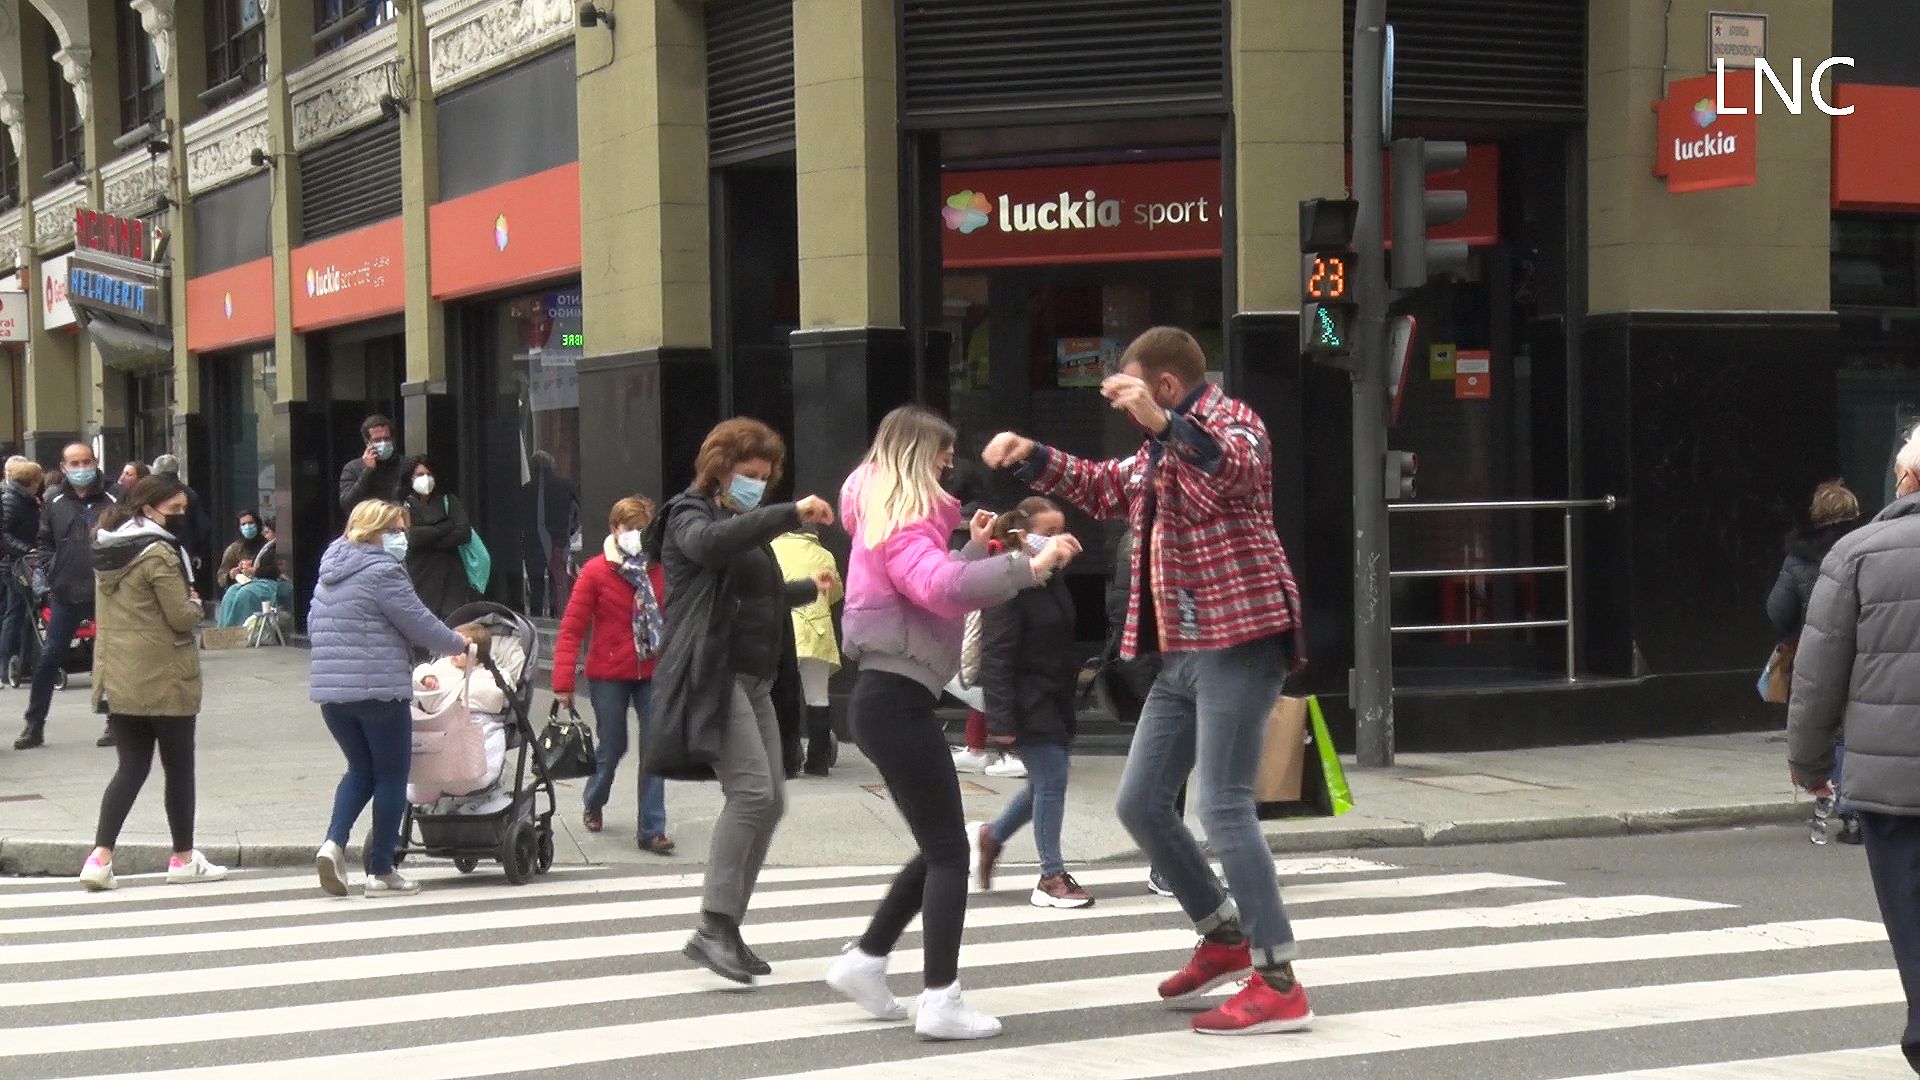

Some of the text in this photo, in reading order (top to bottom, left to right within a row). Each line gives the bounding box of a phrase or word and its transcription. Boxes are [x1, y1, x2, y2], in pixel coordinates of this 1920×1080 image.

[1674, 131, 1736, 161] luckia
[998, 190, 1121, 232] luckia
[1134, 196, 1208, 231] sport
[1308, 257, 1345, 297] 23
